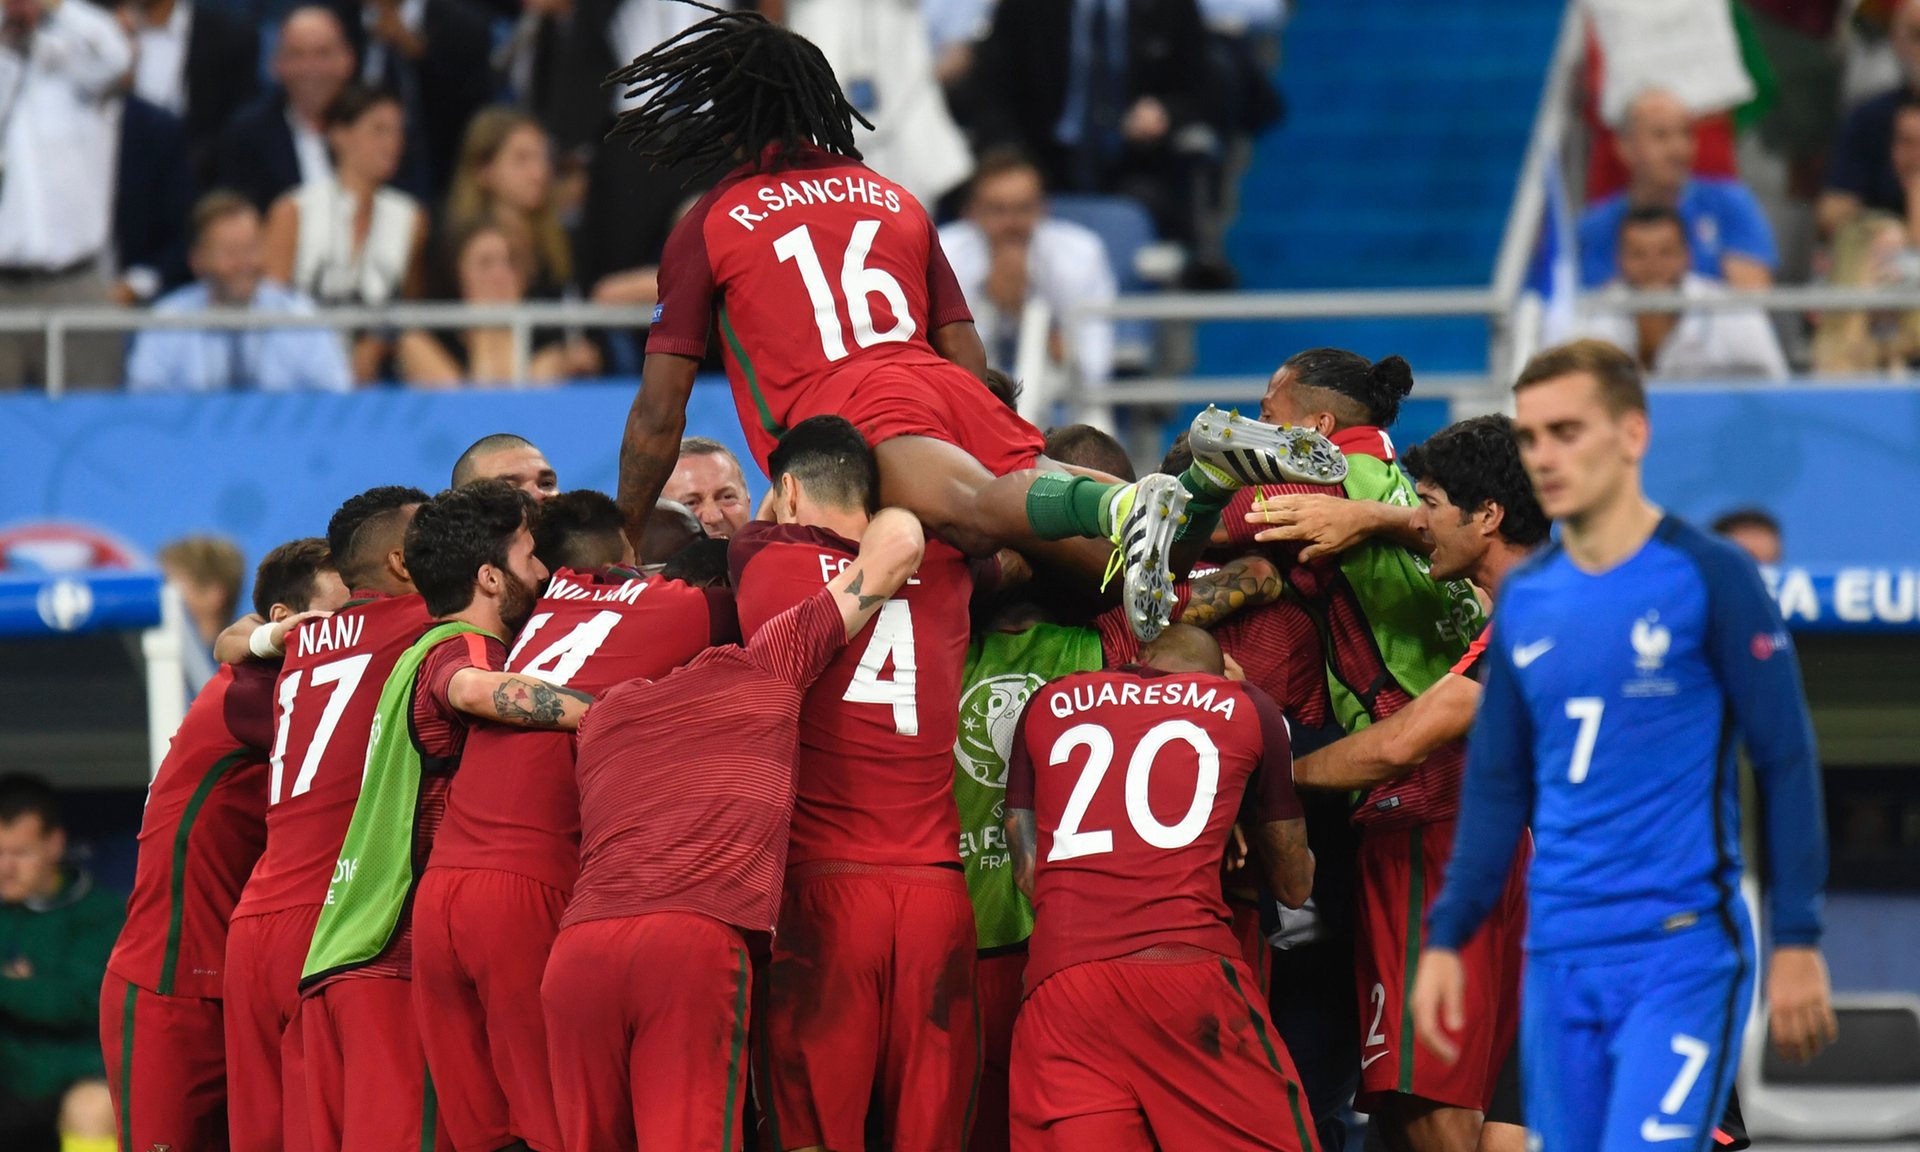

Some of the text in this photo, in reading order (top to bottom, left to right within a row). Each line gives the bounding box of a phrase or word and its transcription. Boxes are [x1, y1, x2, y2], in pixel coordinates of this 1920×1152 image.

[728, 176, 901, 232] R.SANCHES
[772, 219, 917, 362] 16
[1835, 565, 1920, 623] EU
[297, 614, 365, 658] NANI
[503, 609, 623, 687] 14
[842, 599, 919, 736] 4
[269, 653, 373, 806] 17
[1050, 682, 1236, 721] QUARESMA
[1564, 695, 1606, 785] 7
[1047, 719, 1220, 863] 20
[1365, 982, 1386, 1047] 2
[1659, 1033, 1710, 1116] 7
